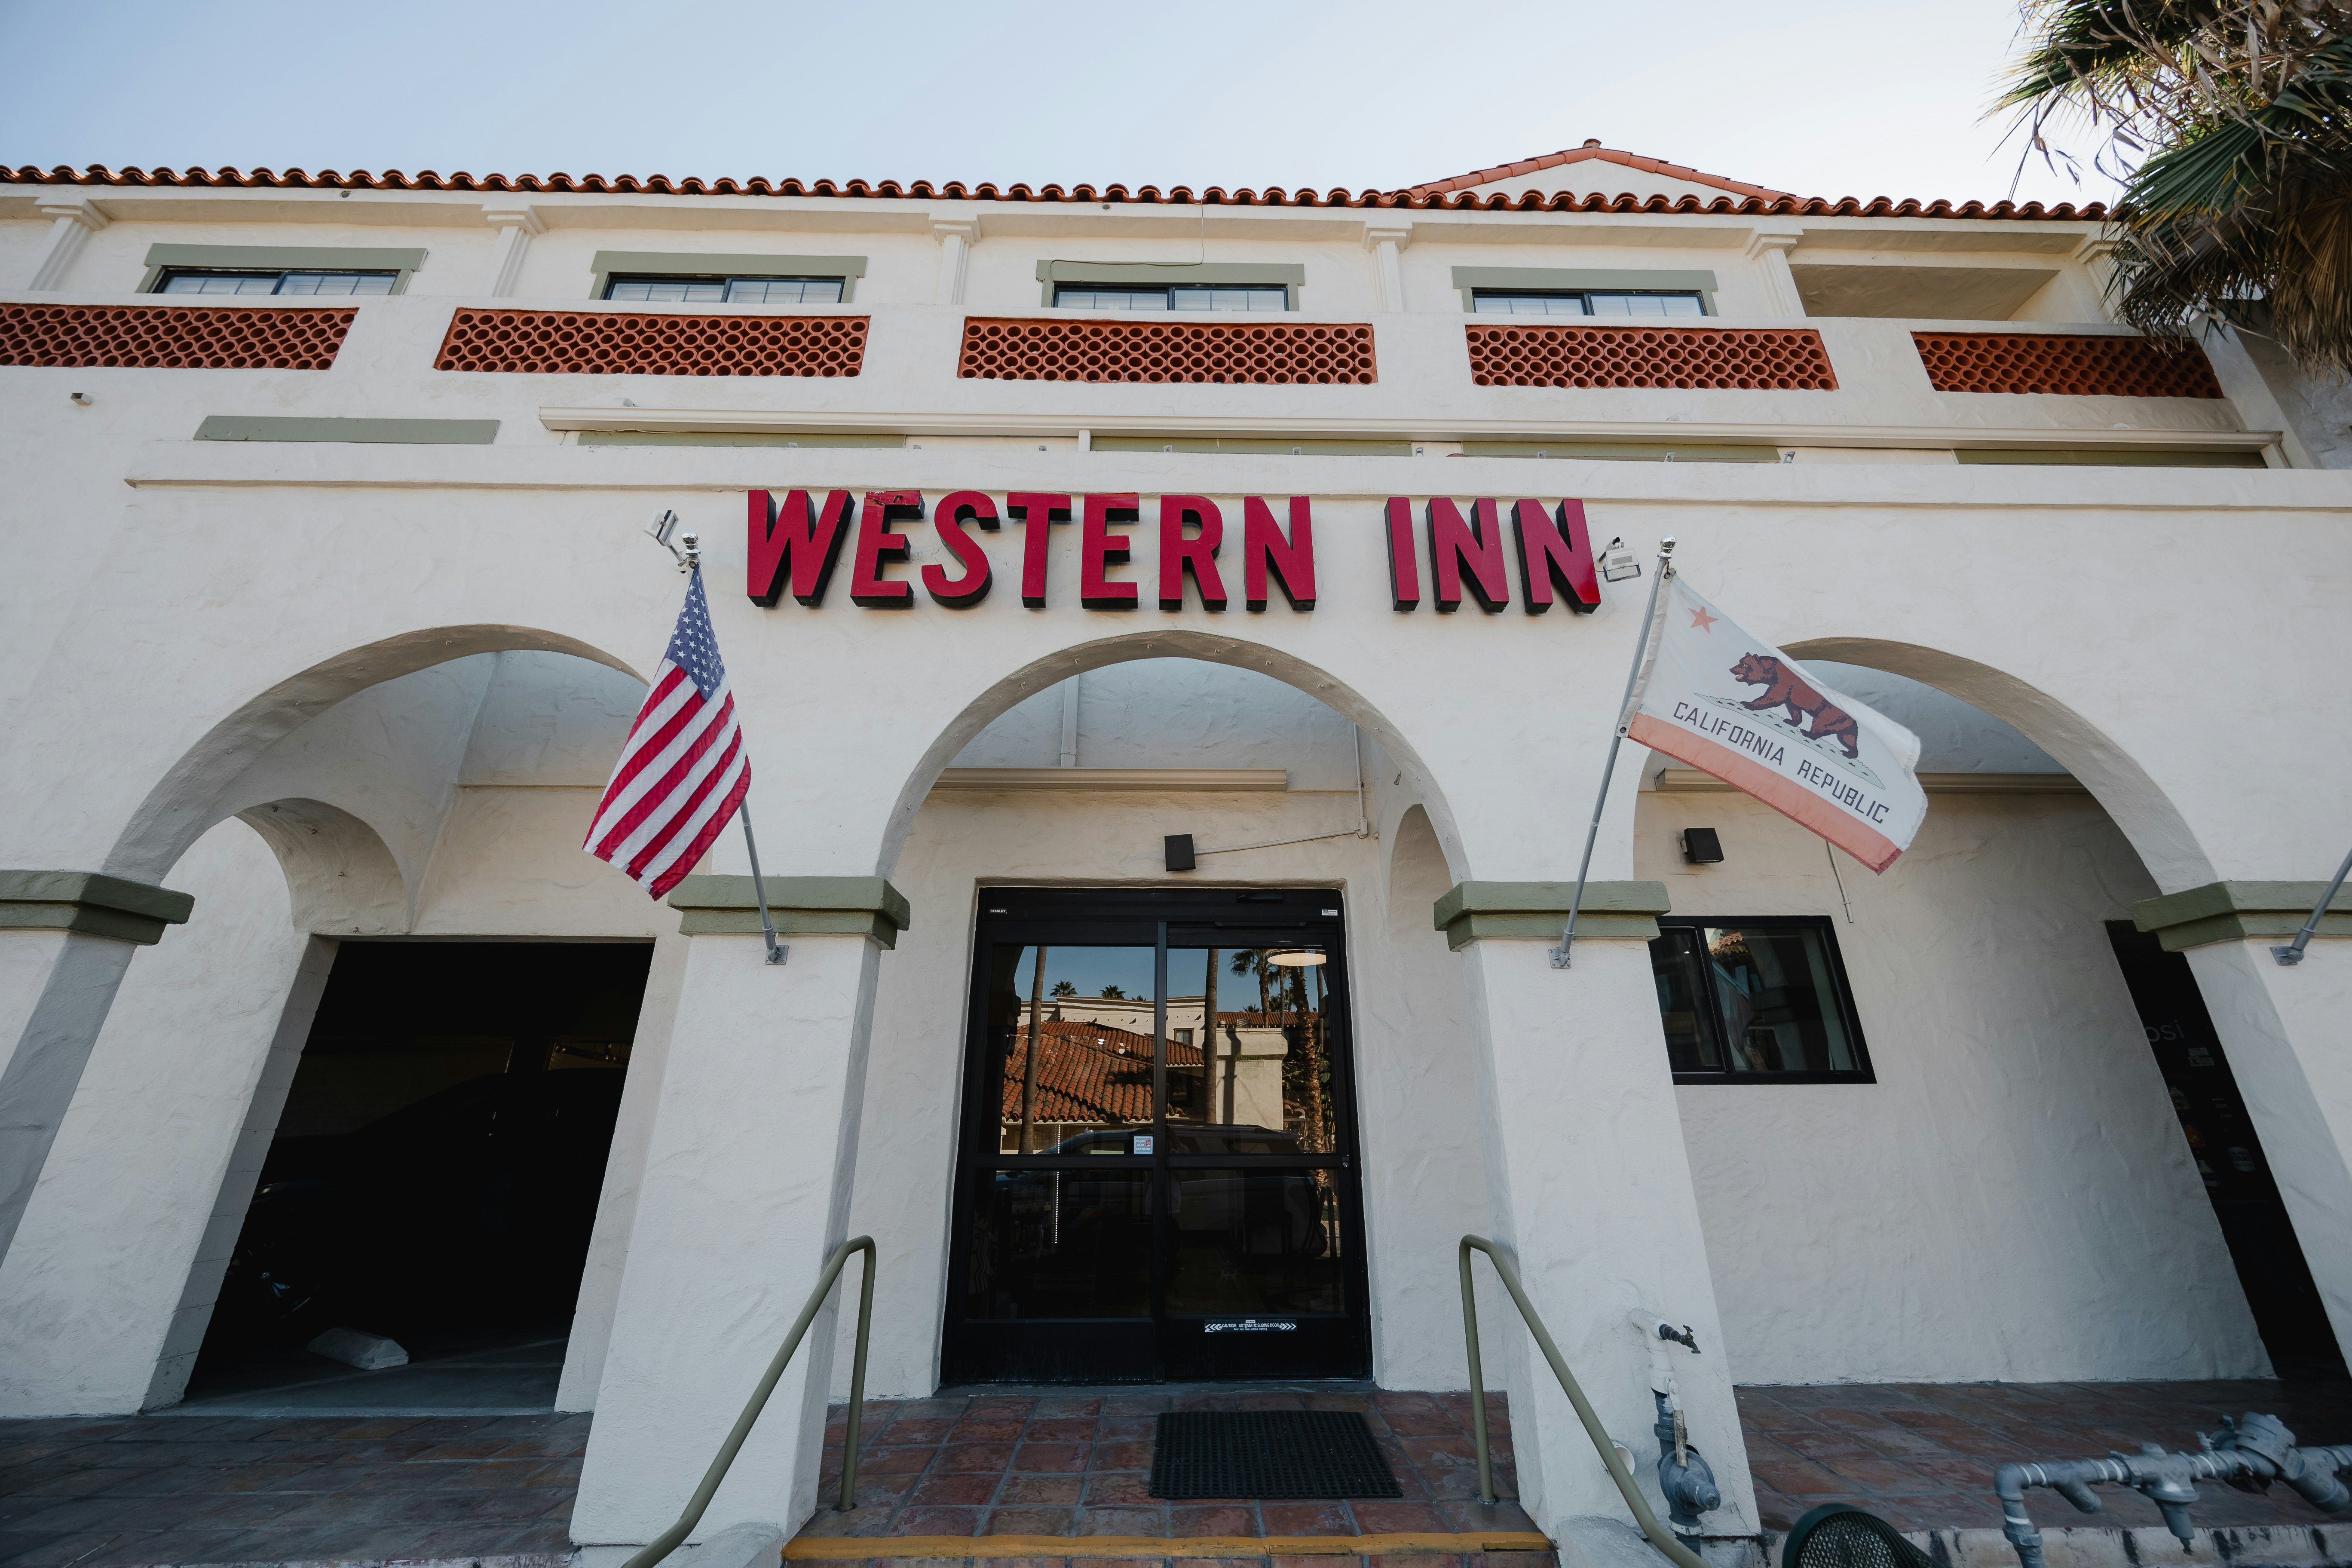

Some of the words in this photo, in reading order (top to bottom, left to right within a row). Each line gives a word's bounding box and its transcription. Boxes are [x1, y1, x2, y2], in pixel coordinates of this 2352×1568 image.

[747, 489, 1316, 612] WESTERN
[1385, 497, 1602, 615] INN
[1673, 702, 1784, 766] CALIFORNIA
[1797, 760, 1889, 824] REPUBLIC
